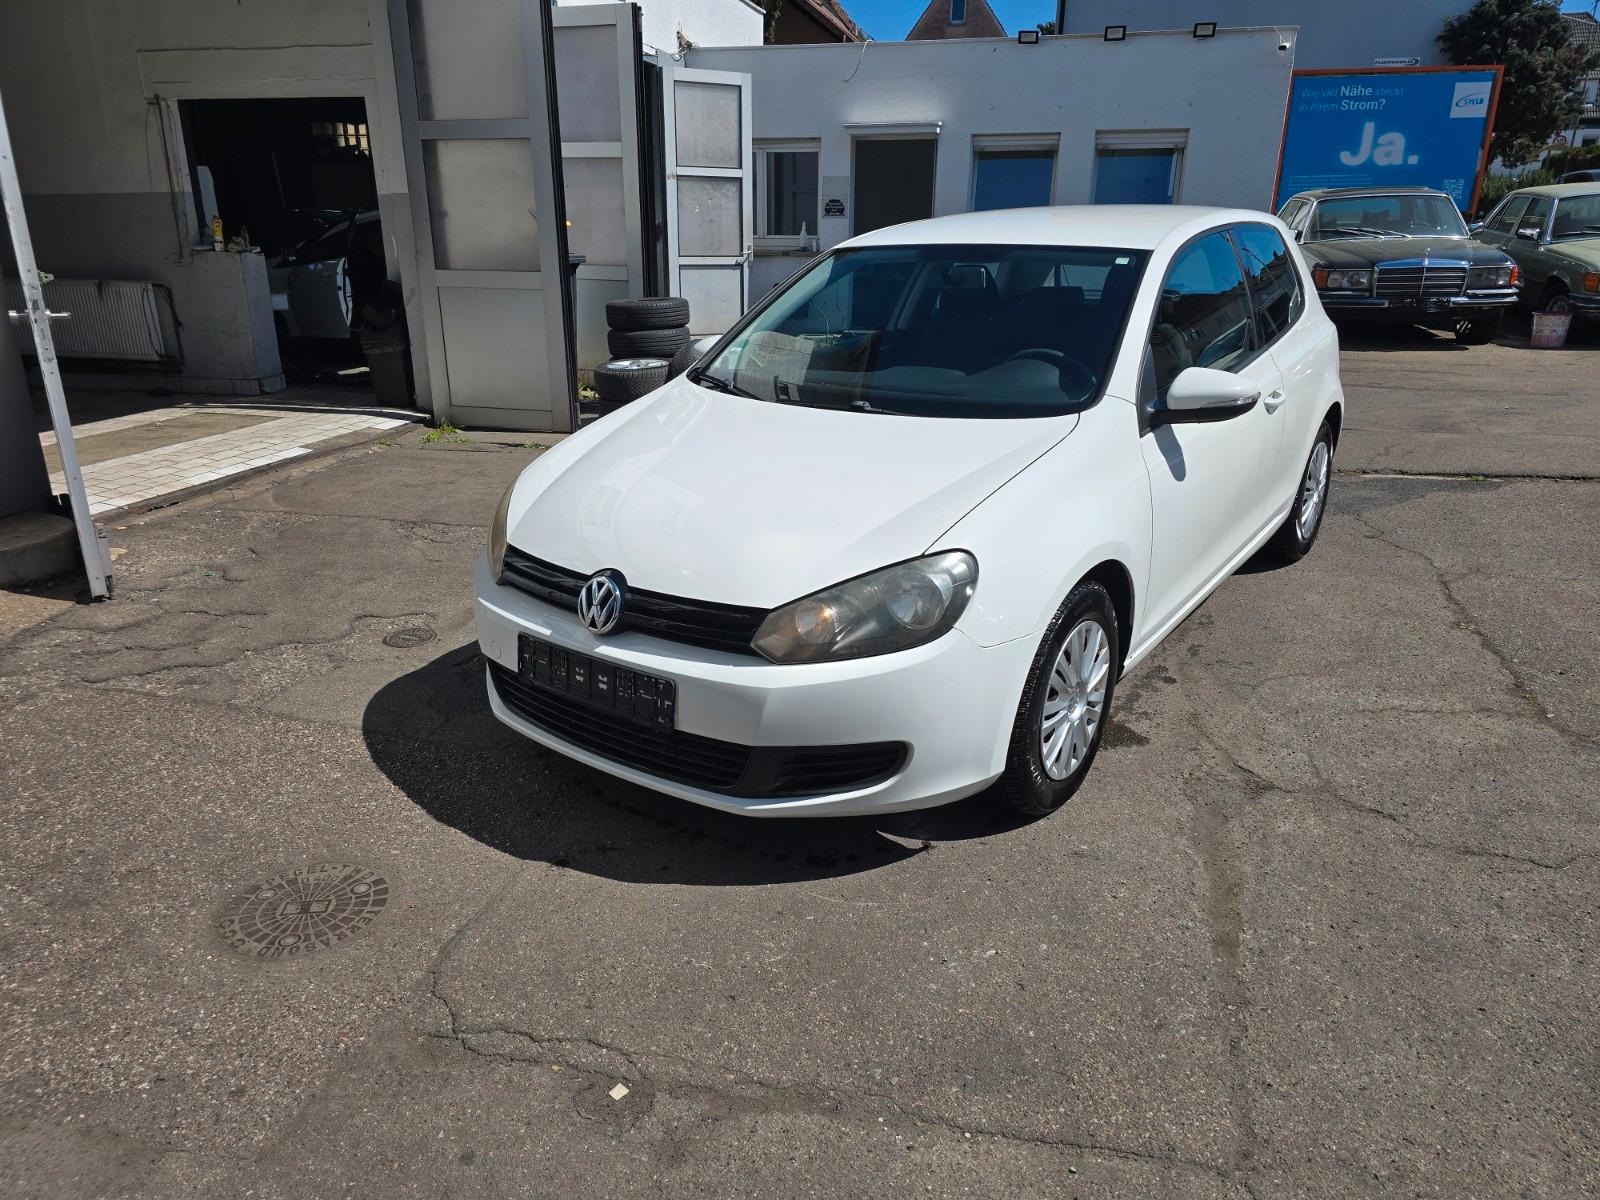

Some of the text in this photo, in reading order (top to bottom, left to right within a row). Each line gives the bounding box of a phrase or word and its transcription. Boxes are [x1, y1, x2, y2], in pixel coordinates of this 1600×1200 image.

[1340, 84, 1372, 96] Nähe
[1374, 87, 1404, 96] steckt
[1310, 102, 1338, 111] Ihrem
[1340, 99, 1386, 110] Strom?
[1340, 121, 1418, 166] Ja.
[578, 577, 621, 633] VW
